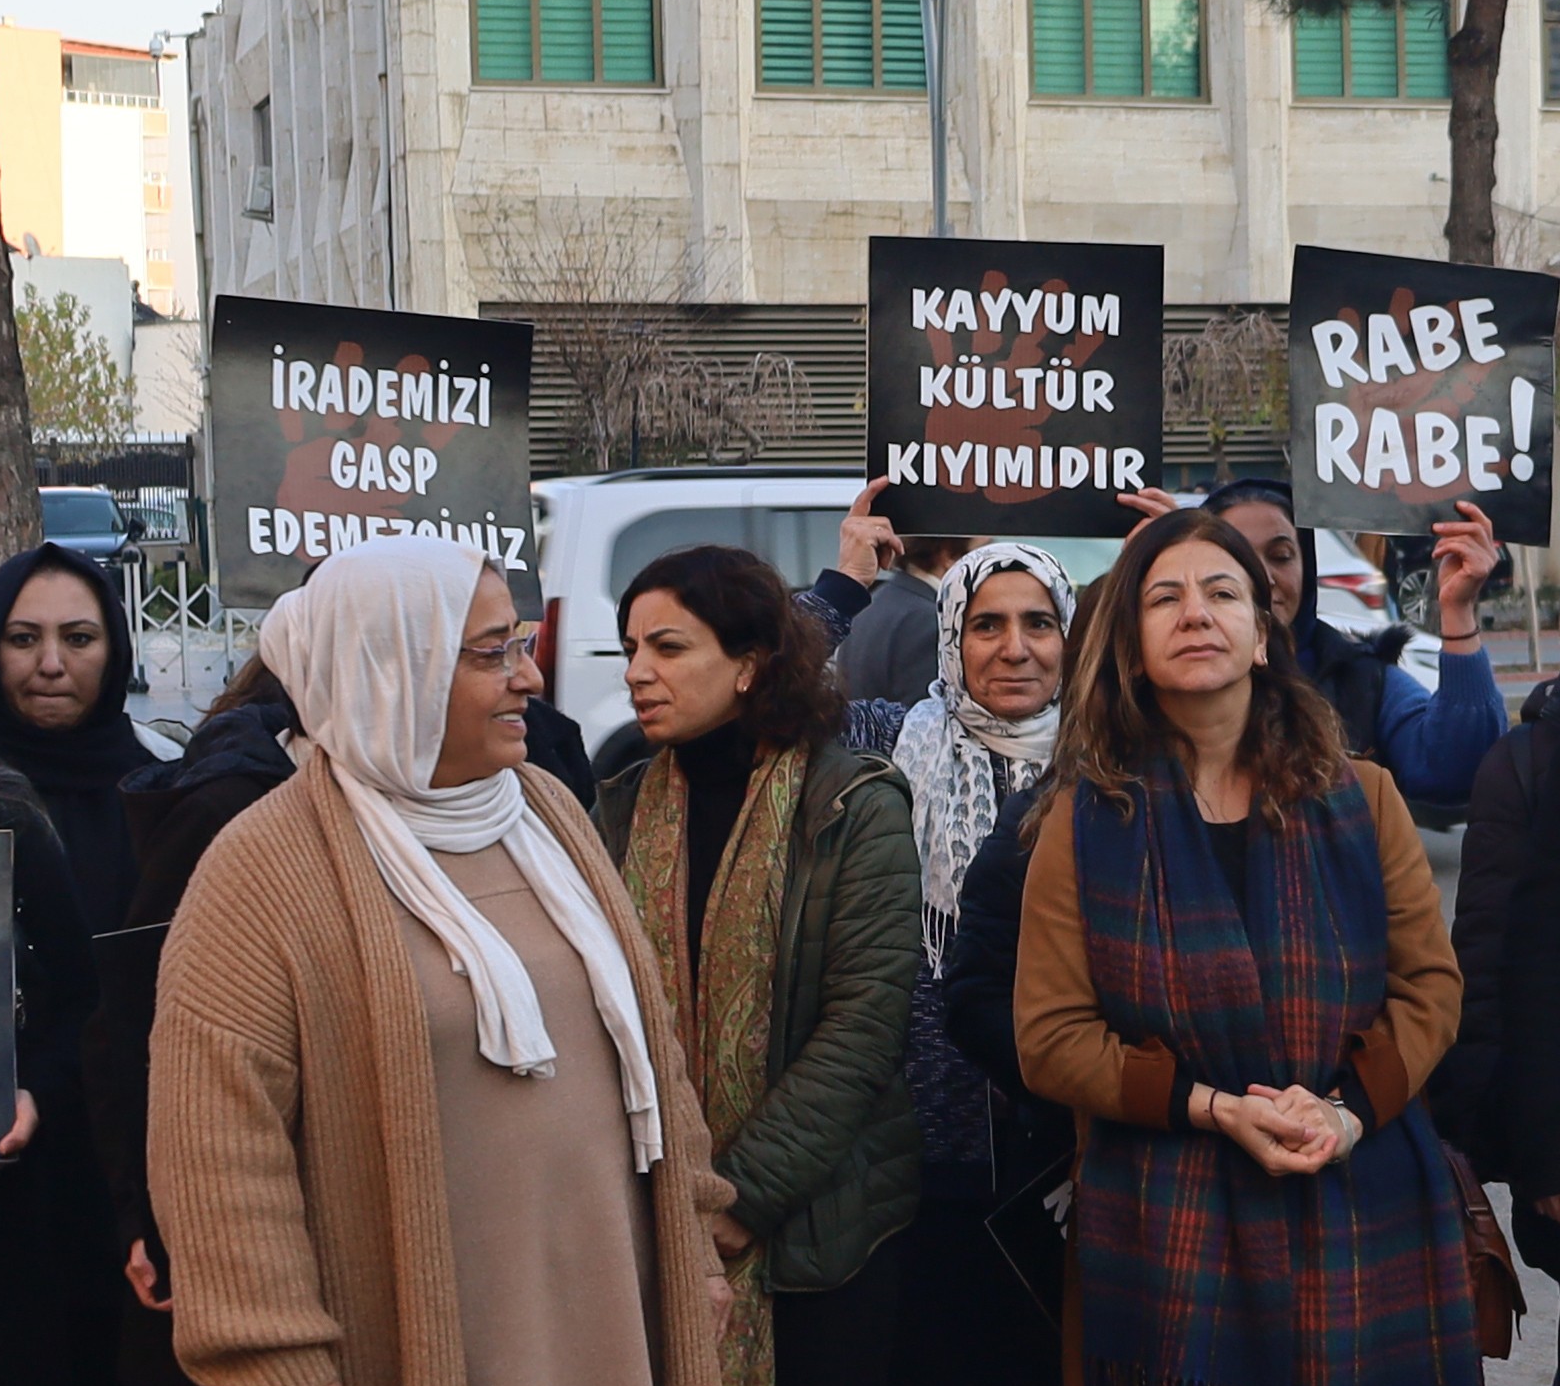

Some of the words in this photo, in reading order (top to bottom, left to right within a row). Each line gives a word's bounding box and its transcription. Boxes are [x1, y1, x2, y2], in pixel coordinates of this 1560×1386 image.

[912, 287, 1120, 336] KAYYUM
[1311, 298, 1507, 389] RABE
[272, 344, 490, 428] İRADEMİZİ
[920, 354, 1114, 413] KÜLTÜR
[1315, 376, 1536, 492] RABE!
[330, 440, 438, 496] GASP
[888, 441, 1146, 491] KIYIMIDIR
